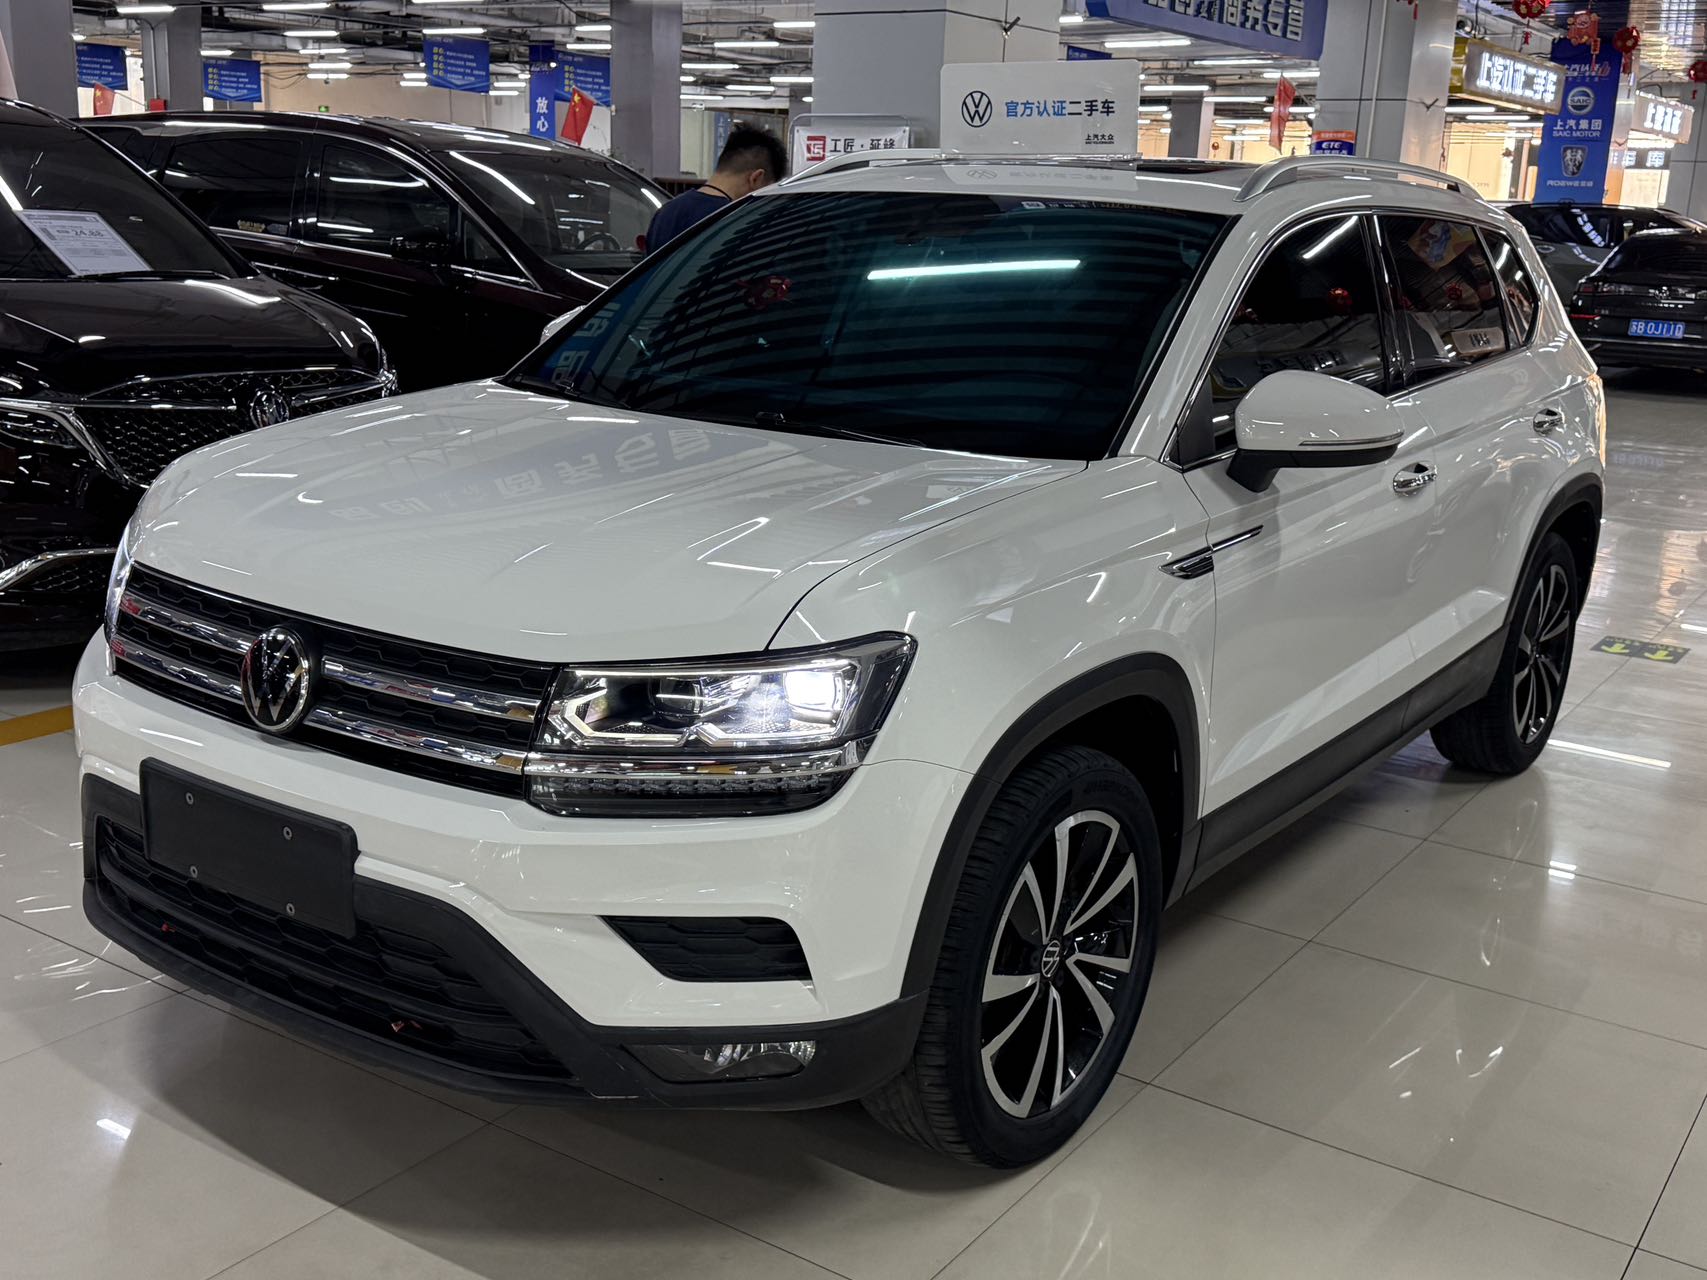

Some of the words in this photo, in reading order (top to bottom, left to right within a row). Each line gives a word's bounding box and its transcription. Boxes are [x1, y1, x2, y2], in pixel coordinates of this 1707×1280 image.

[1569, 96, 1592, 105] SAIC
[535, 96, 549, 132] 放心
[1005, 99, 1116, 118] 官方认证二手车
[1553, 119, 1603, 130] 上汽集团
[1084, 133, 1115, 141] 上汽大众
